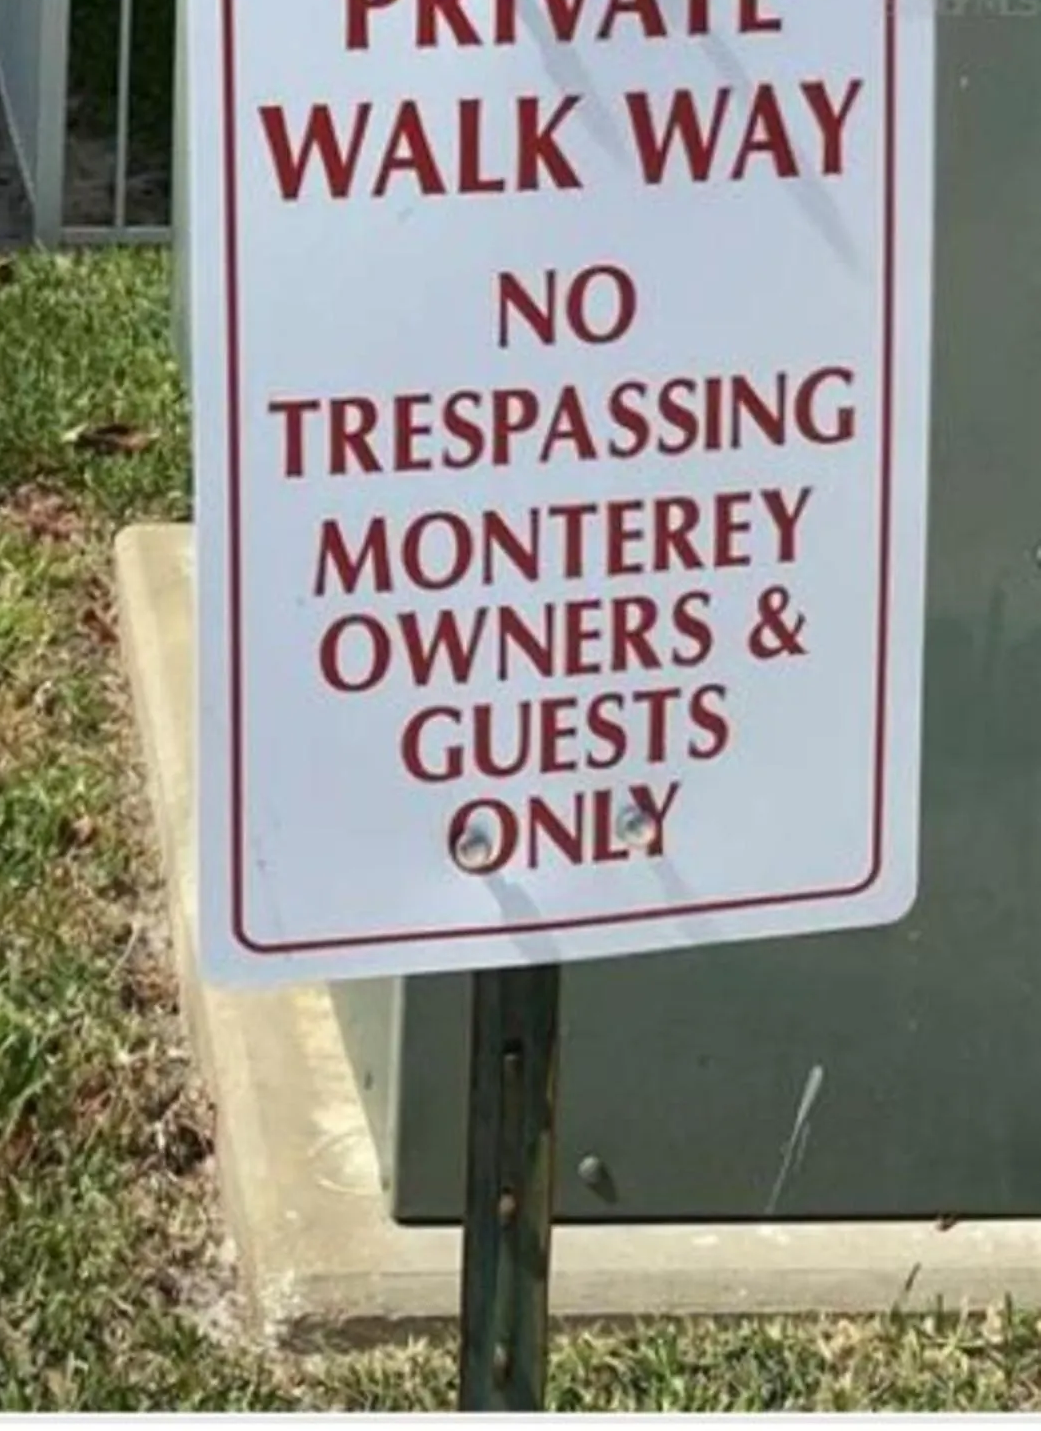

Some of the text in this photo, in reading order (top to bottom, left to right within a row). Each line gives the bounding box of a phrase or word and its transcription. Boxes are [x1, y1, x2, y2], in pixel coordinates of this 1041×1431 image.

[261, 79, 864, 199] WALK WAY
[497, 266, 636, 347] NO
[269, 368, 856, 477] TRESPASSING
[315, 488, 813, 595] MONTEREY
[320, 586, 807, 692] OWNERS &
[402, 685, 729, 782] GUESTS
[449, 783, 682, 874] ONLY
